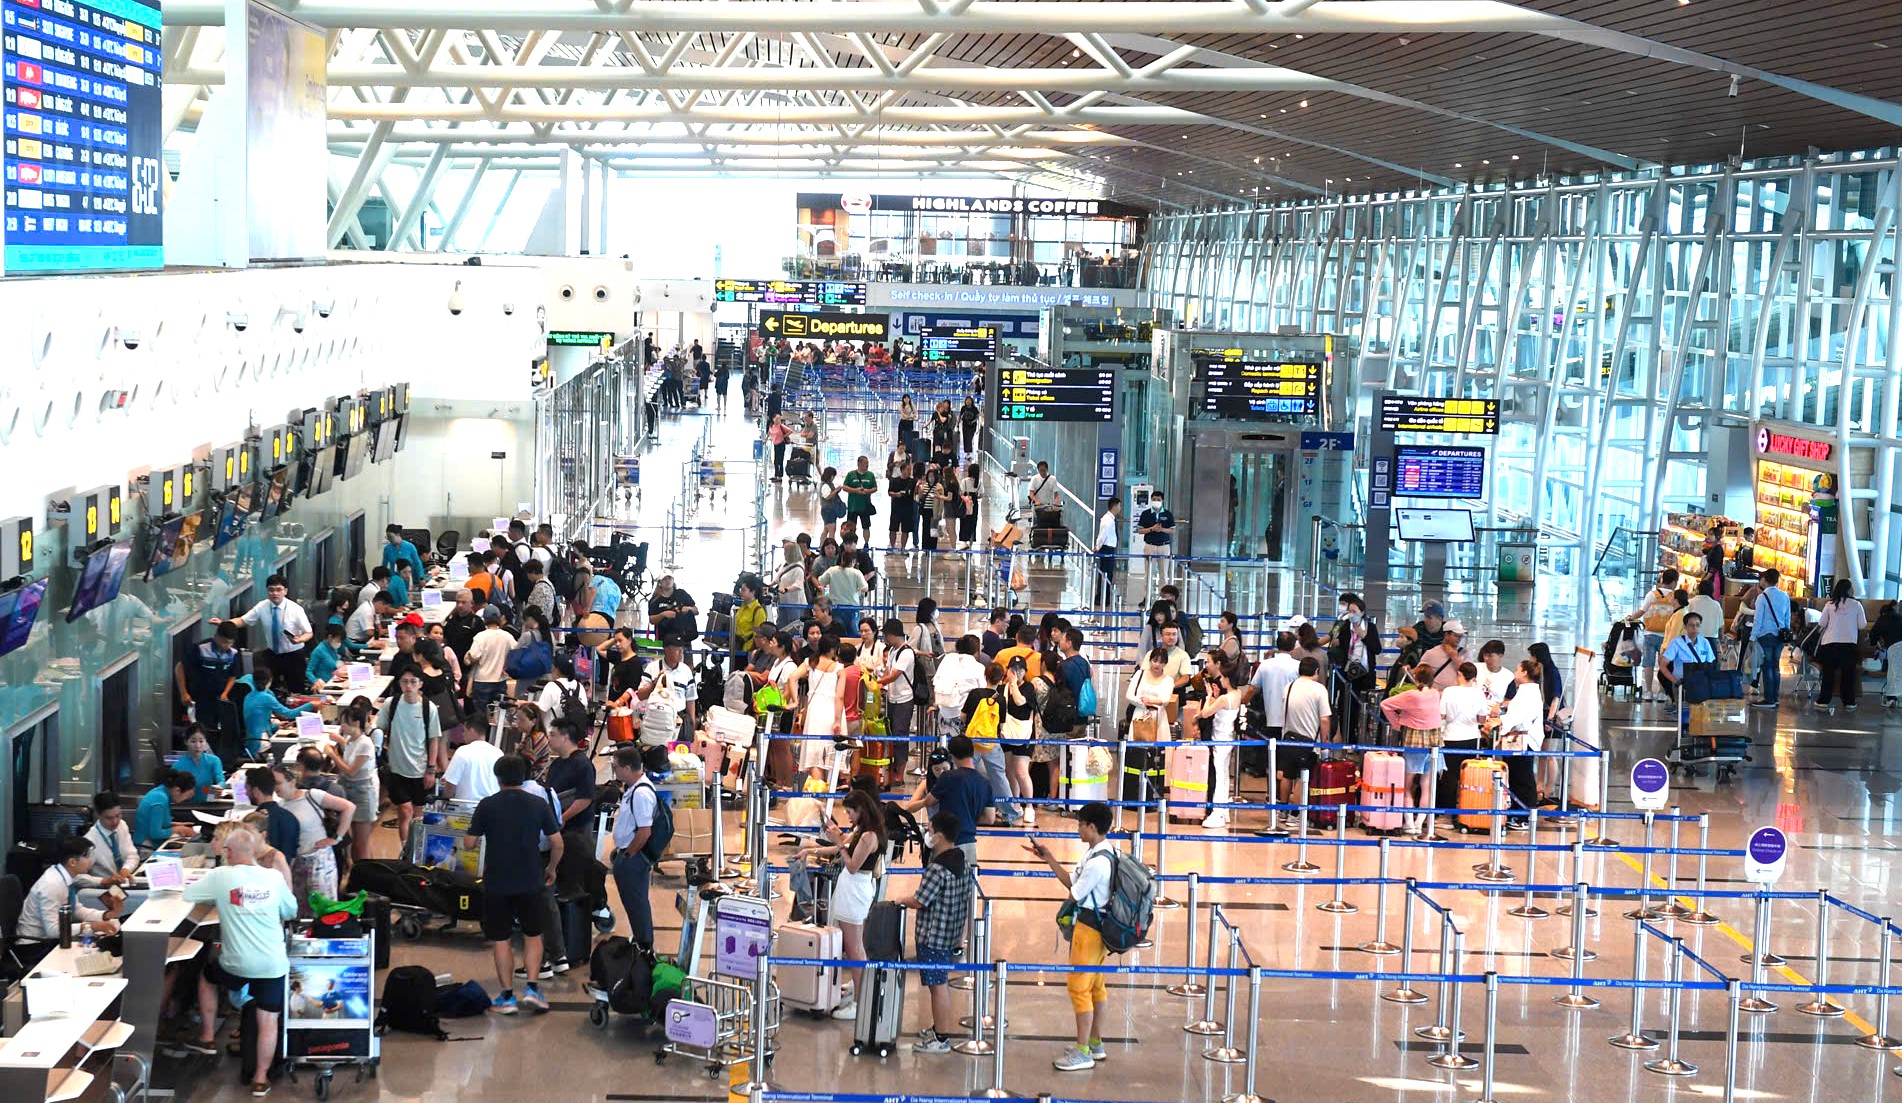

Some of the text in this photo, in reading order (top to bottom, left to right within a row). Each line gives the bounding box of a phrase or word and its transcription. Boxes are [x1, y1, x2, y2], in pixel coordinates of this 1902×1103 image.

[912, 197, 1099, 214] HIGHLANDS COFFEE
[890, 290, 911, 300] Self
[912, 290, 952, 301] check-in
[1002, 292, 1020, 302] làm
[810, 318, 884, 336] Departures
[1320, 438, 1337, 450] 2F
[1770, 434, 1830, 461] LUCKY GIFT SHOP
[21, 530, 32, 561] 12
